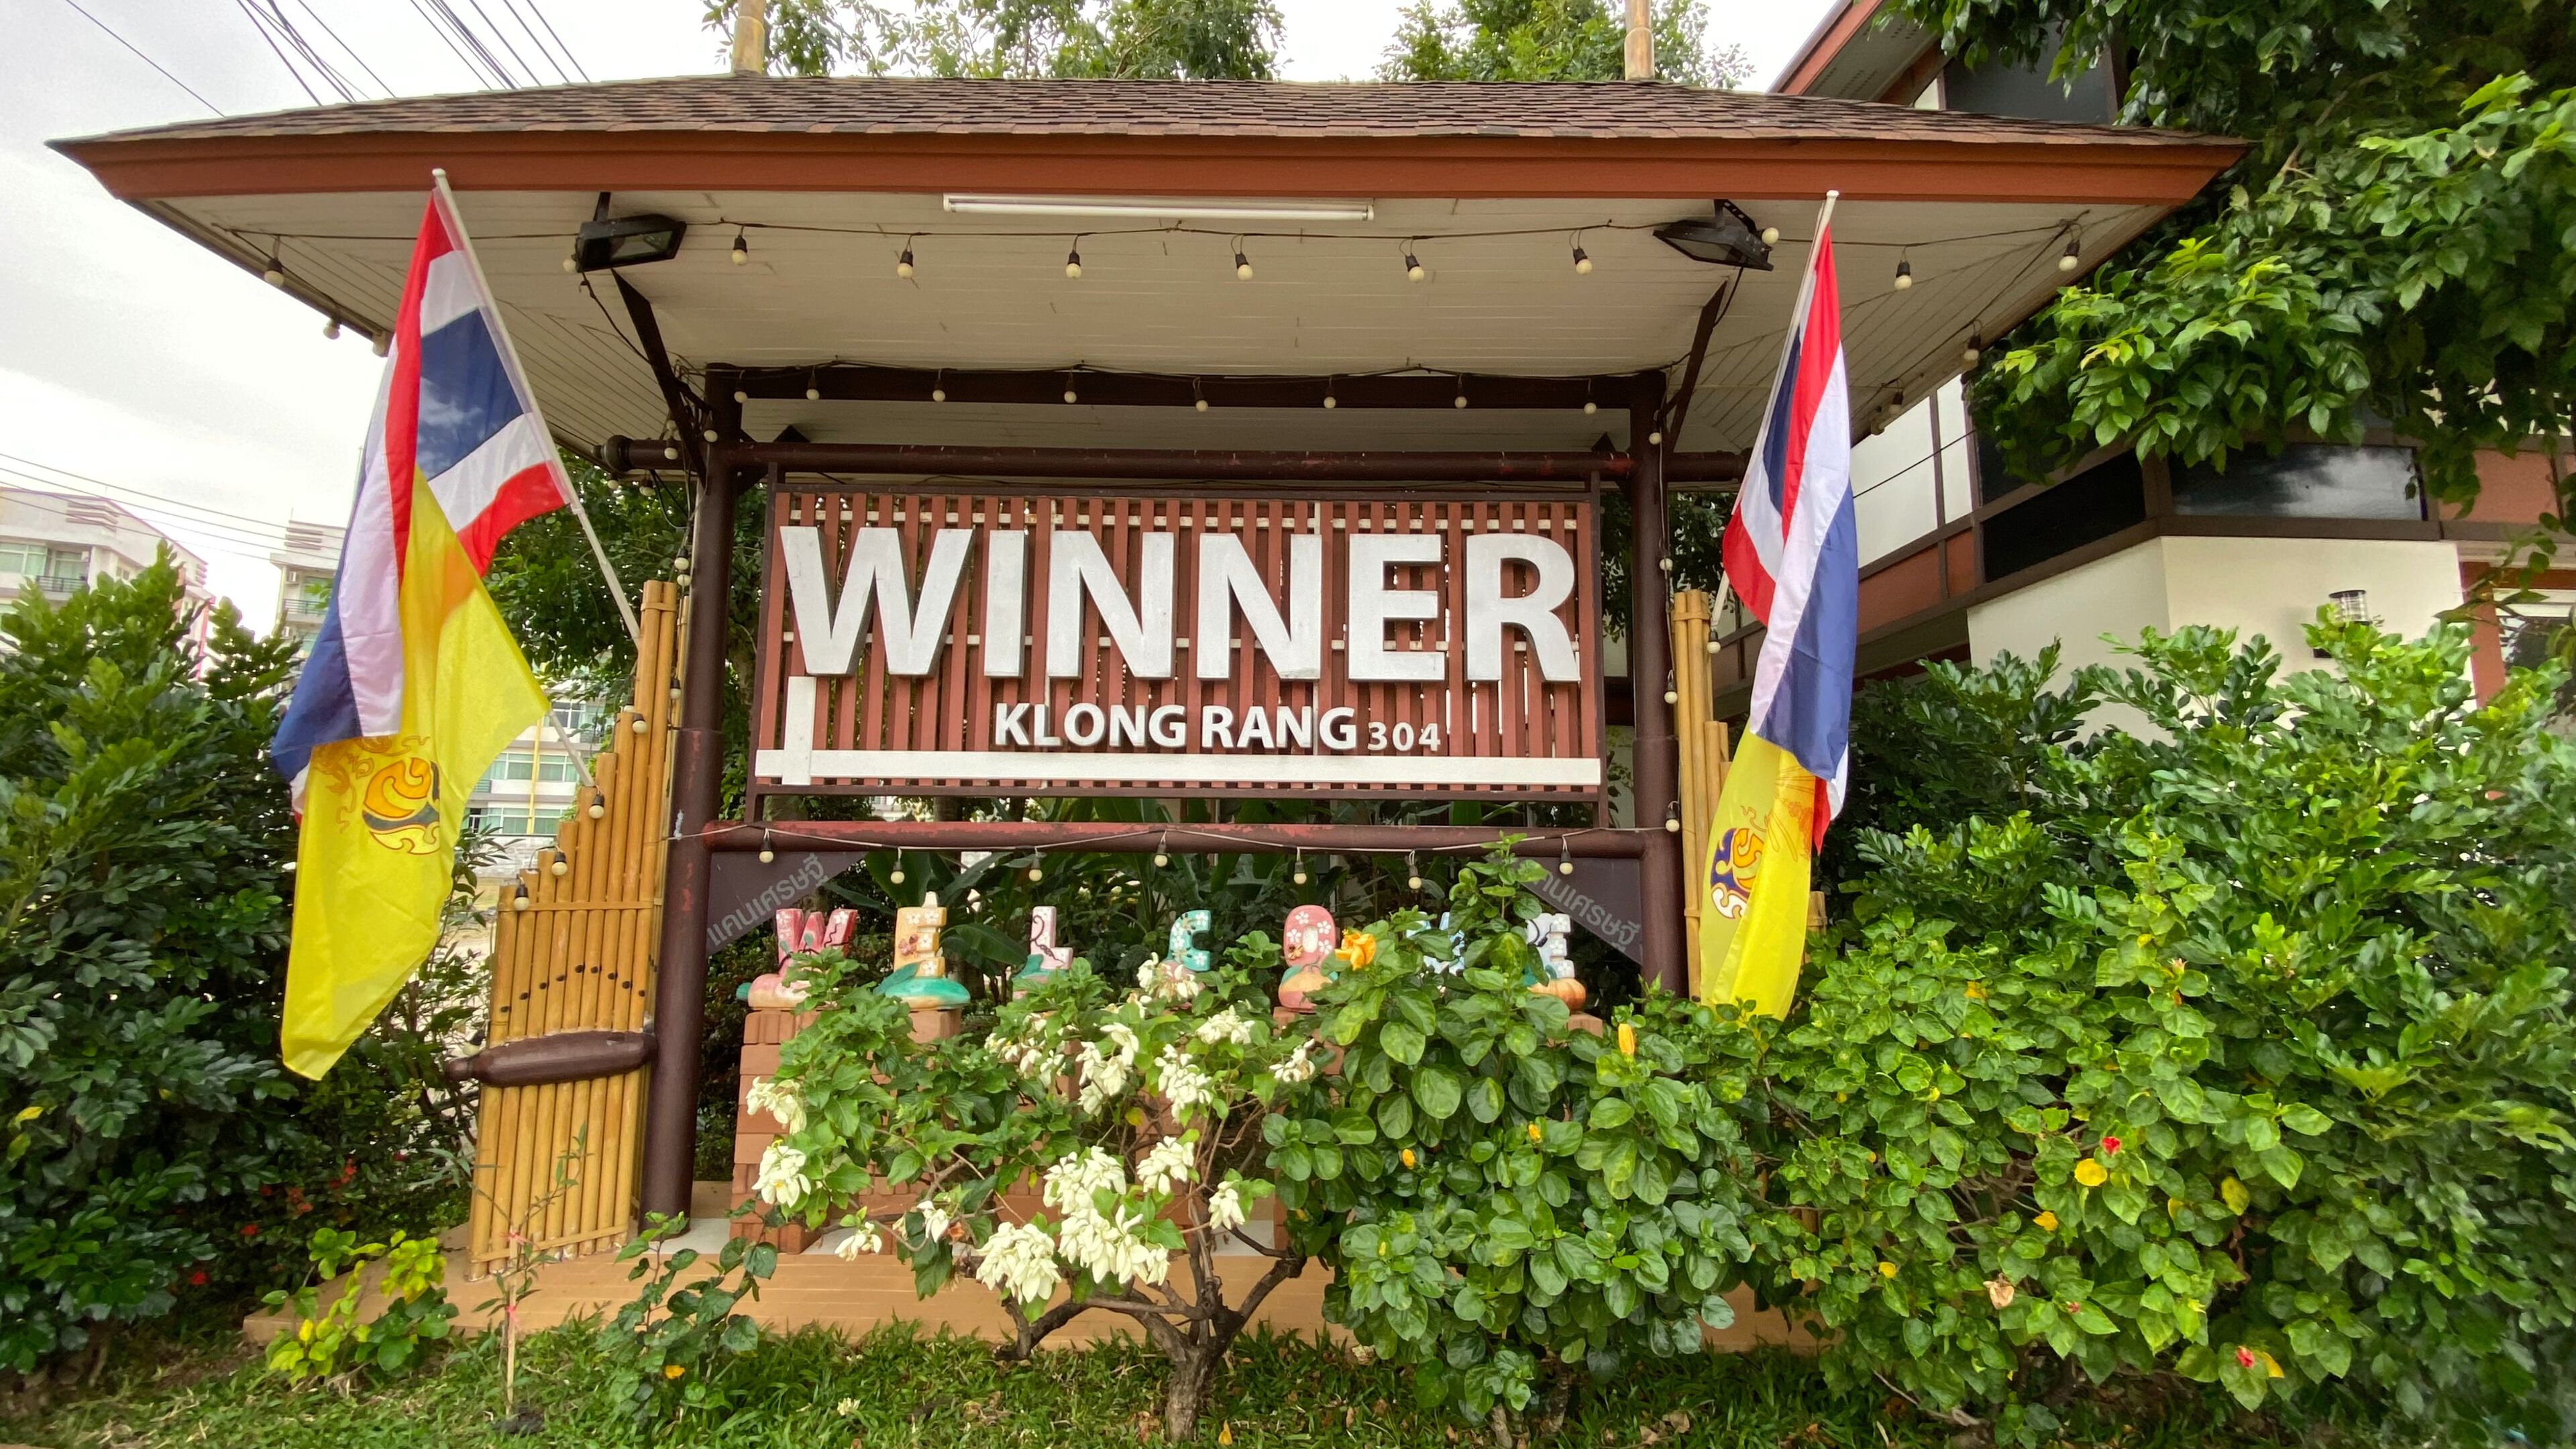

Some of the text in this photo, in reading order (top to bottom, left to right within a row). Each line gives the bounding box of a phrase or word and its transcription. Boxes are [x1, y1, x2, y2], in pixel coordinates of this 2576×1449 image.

[780, 525, 1581, 683] WINNER
[995, 702, 1442, 752] KLONG RANG 304
